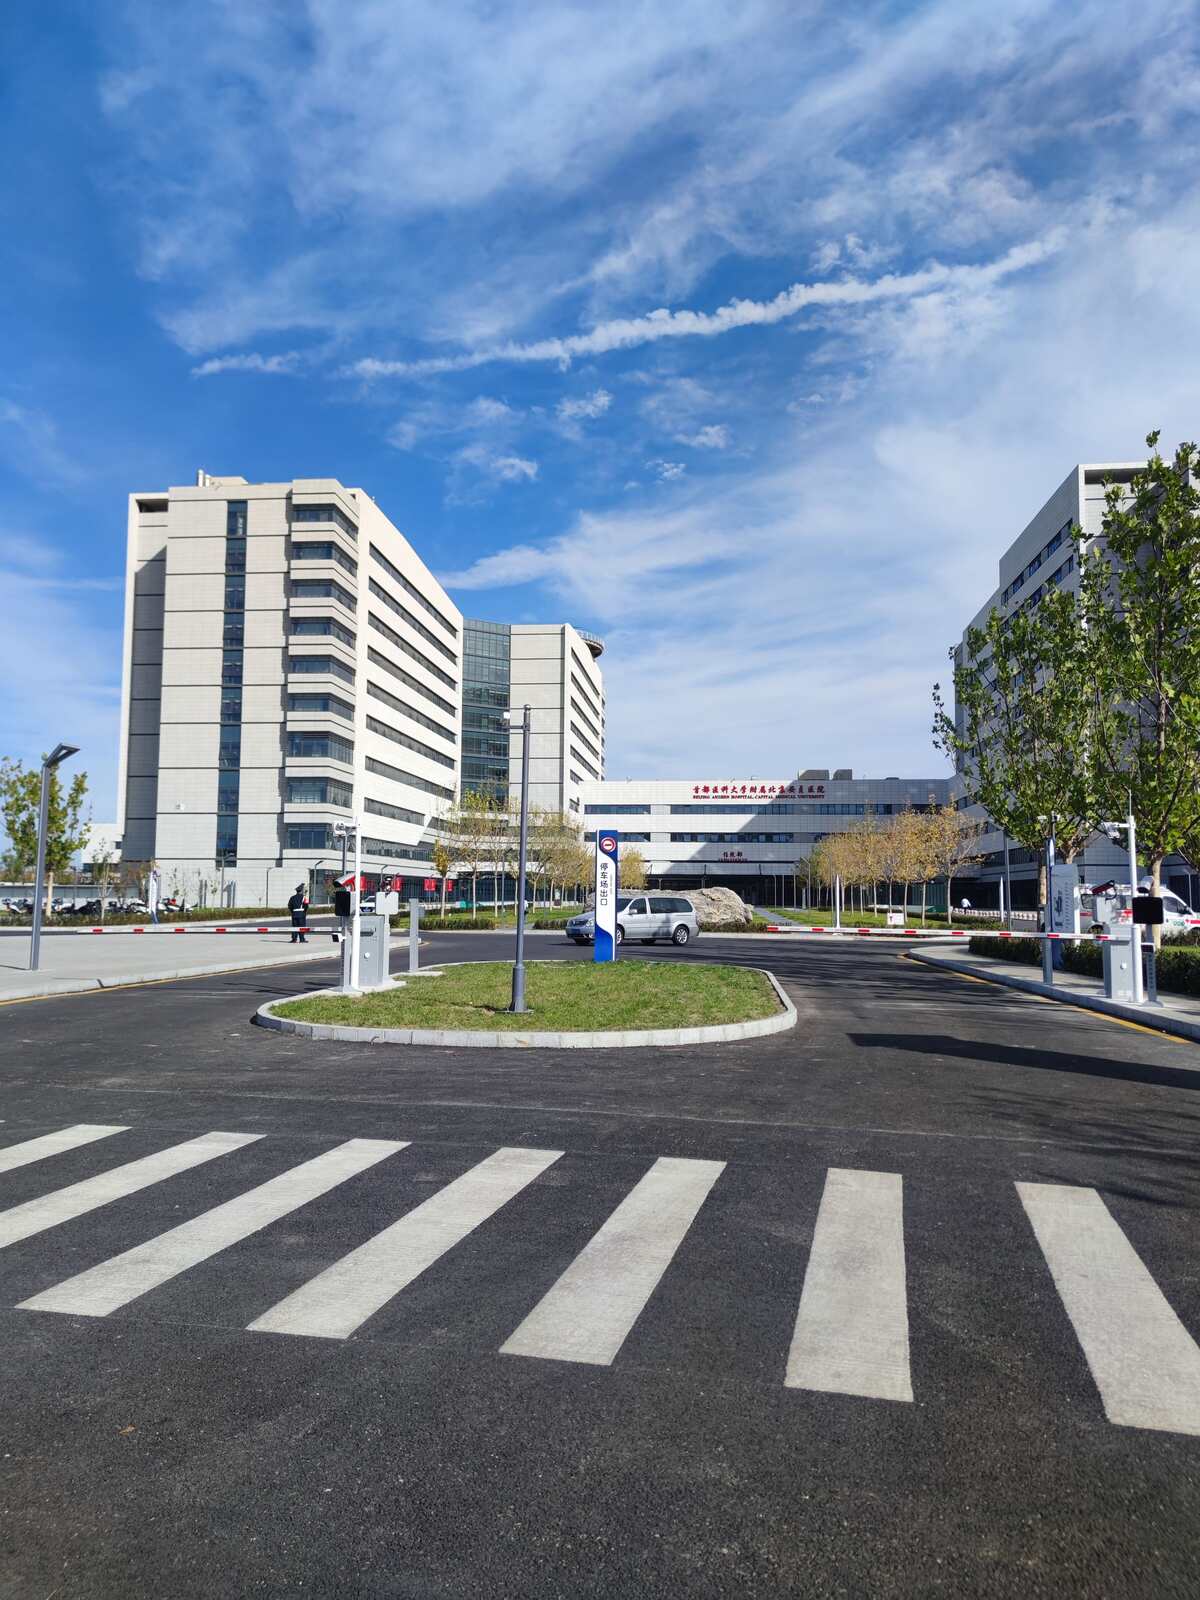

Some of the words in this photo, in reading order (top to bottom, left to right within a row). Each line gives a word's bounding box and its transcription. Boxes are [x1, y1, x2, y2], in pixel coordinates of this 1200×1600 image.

[600, 863, 609, 906] 停车场出口
